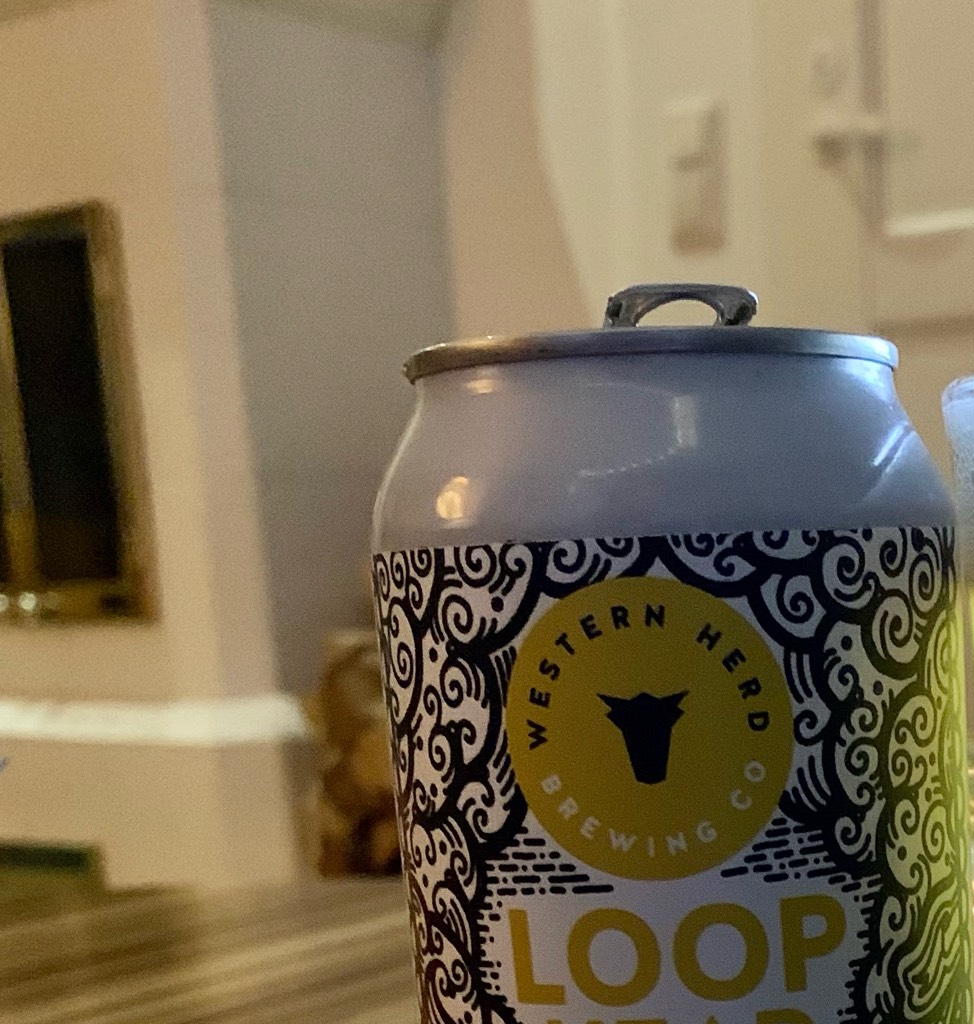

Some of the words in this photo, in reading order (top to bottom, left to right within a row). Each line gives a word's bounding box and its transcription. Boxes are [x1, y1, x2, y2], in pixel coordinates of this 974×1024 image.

[527, 604, 666, 750] WESTERN
[696, 623, 770, 732] HERD
[541, 774, 718, 858] BREWING
[731, 761, 766, 811] CO
[508, 893, 847, 1008] LOOP
